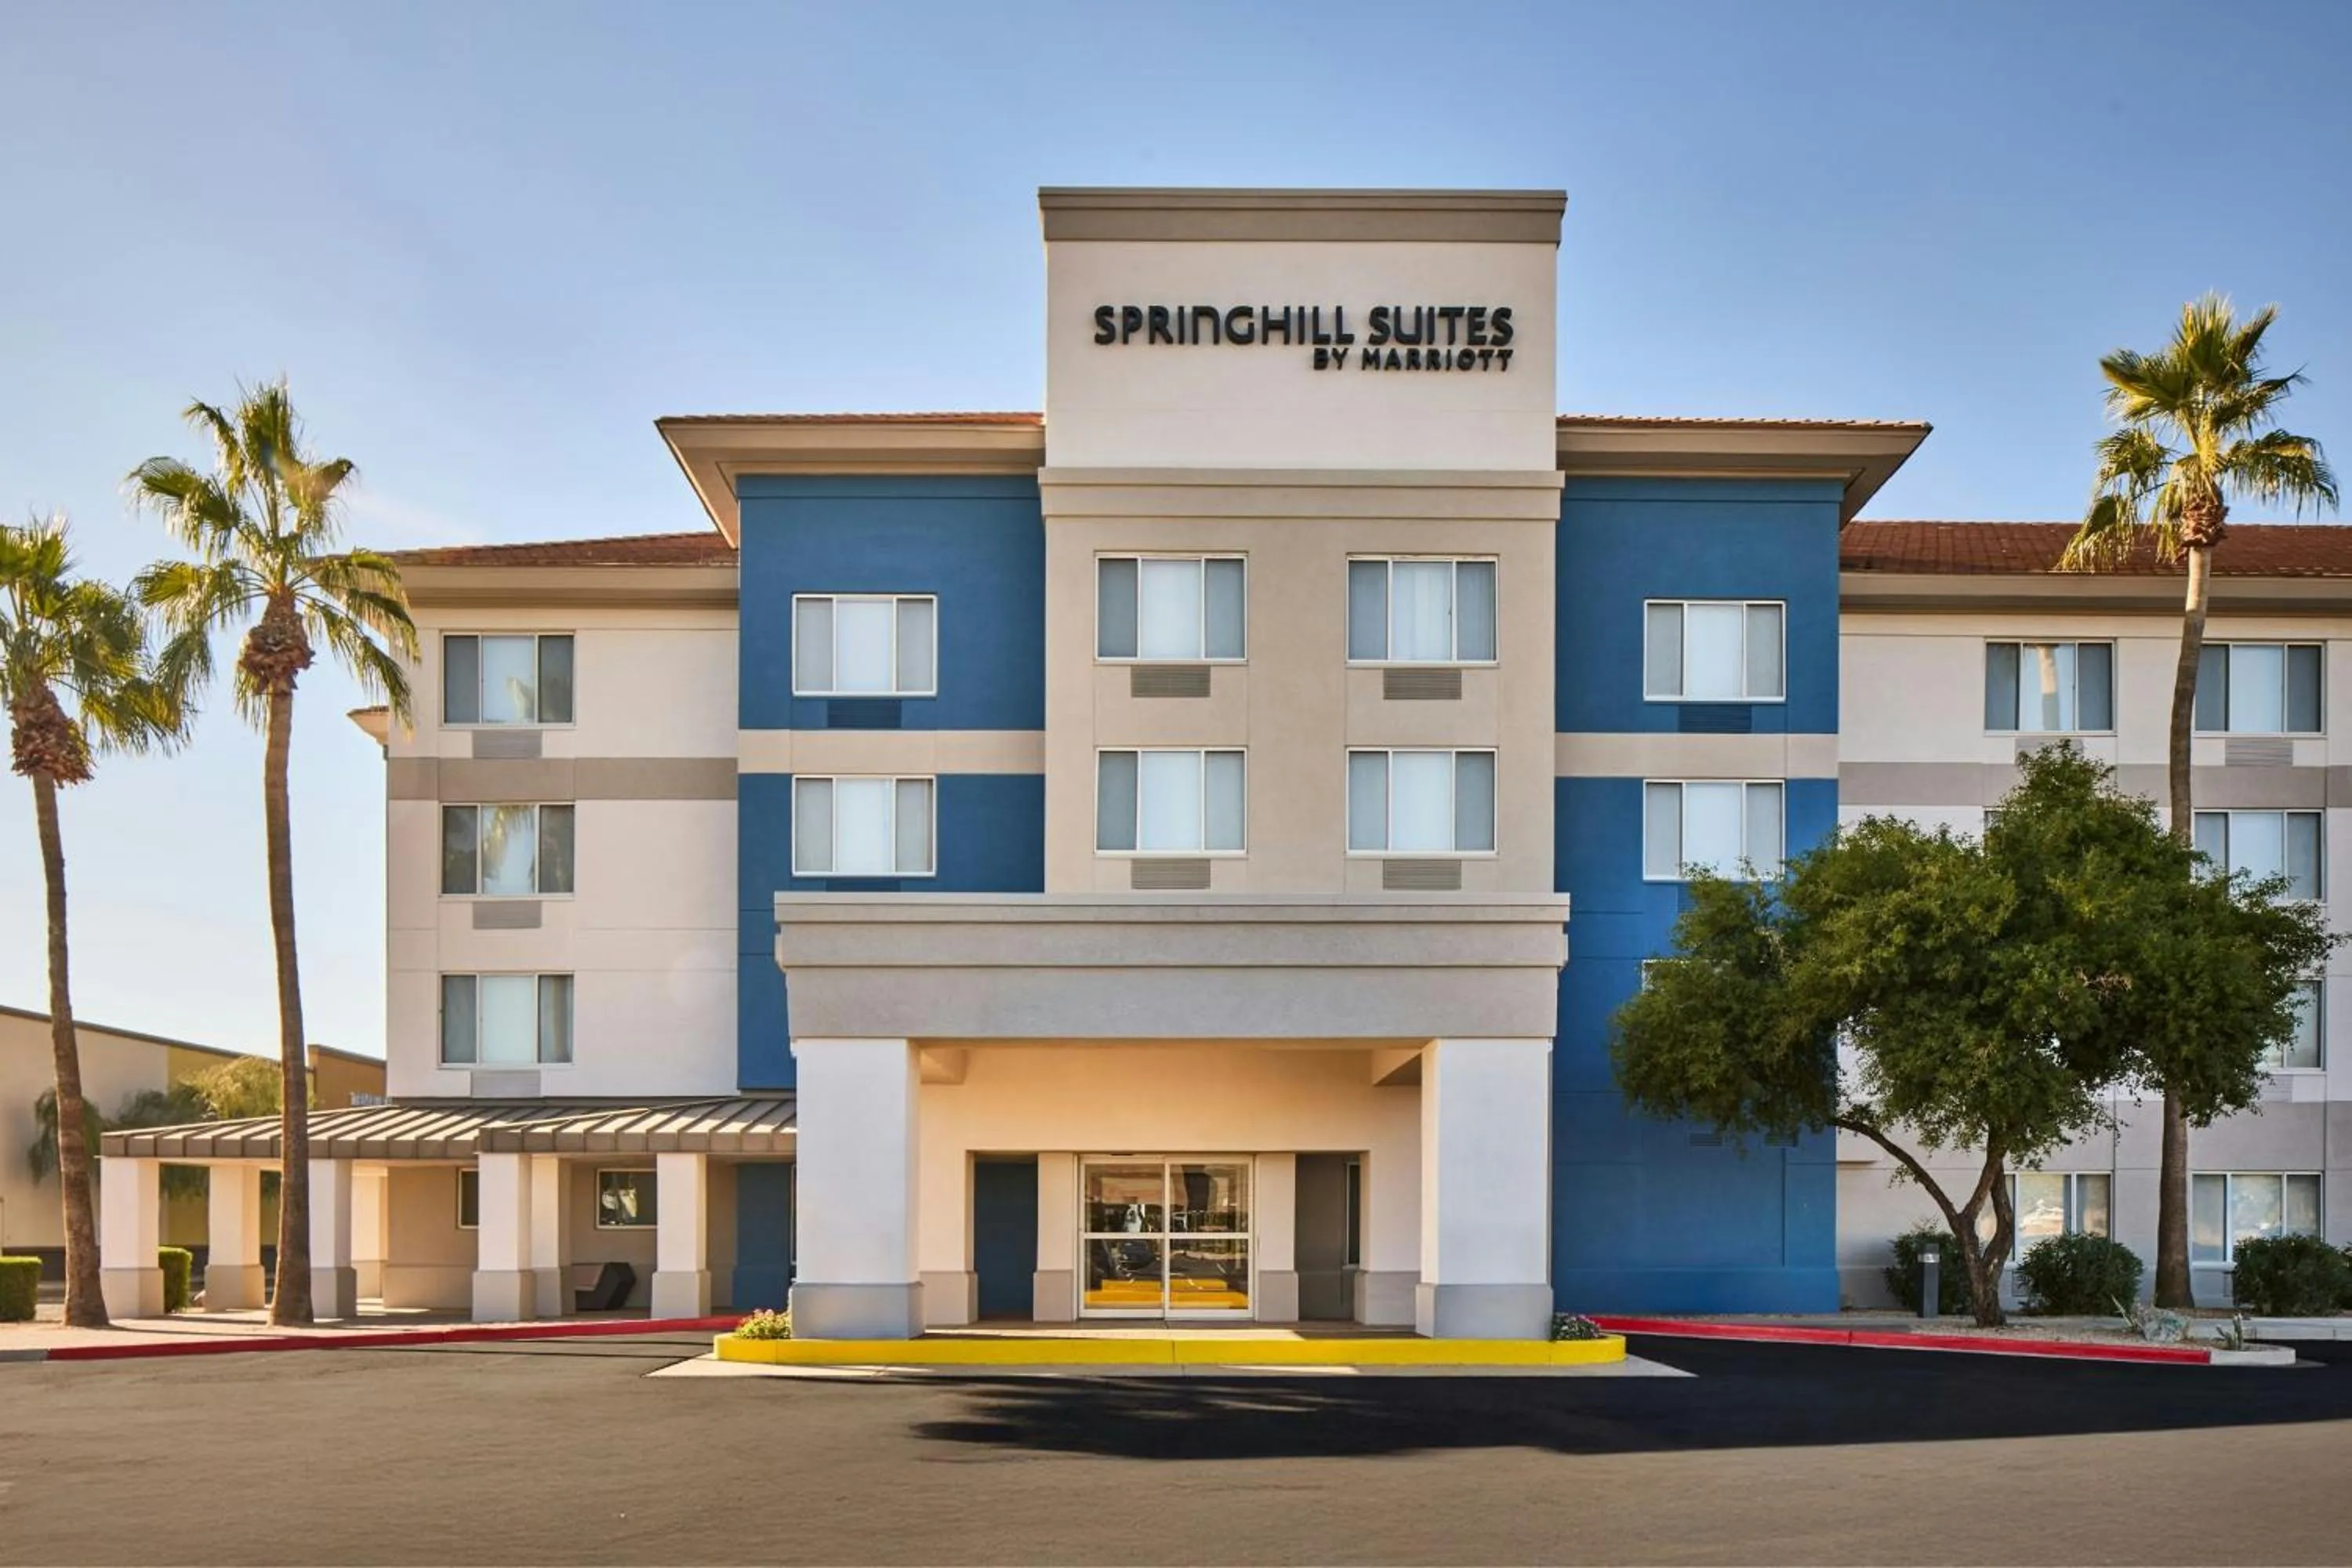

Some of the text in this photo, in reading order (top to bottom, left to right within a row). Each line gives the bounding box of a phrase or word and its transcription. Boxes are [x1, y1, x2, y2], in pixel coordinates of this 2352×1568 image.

[1094, 305, 1514, 347] SPRINGHILL SUITES
[1312, 347, 1514, 372] BY MARRIOTT
